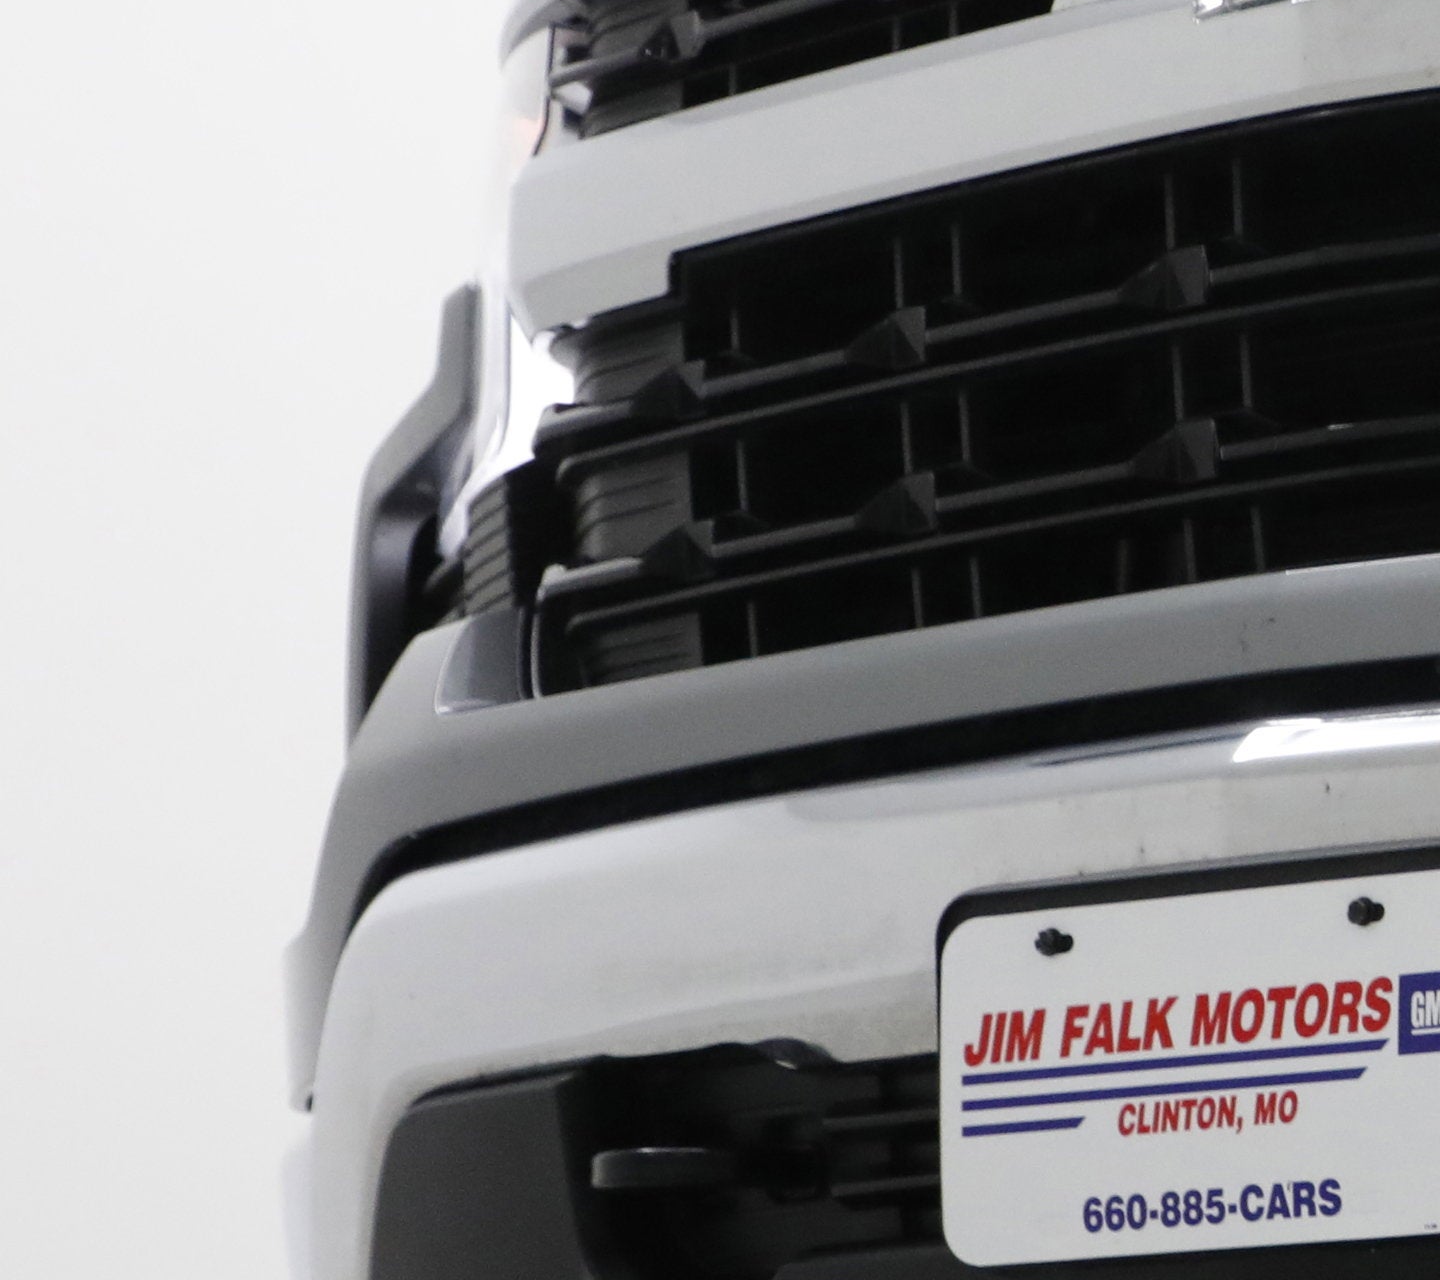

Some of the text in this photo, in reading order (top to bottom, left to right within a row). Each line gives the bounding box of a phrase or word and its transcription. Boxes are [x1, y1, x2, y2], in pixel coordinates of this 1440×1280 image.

[964, 976, 1394, 1067] JIM FALK MOTORS
[1117, 1090, 1299, 1137] CLINTON, MO
[1083, 1178, 1343, 1234] 660-885-CARS
